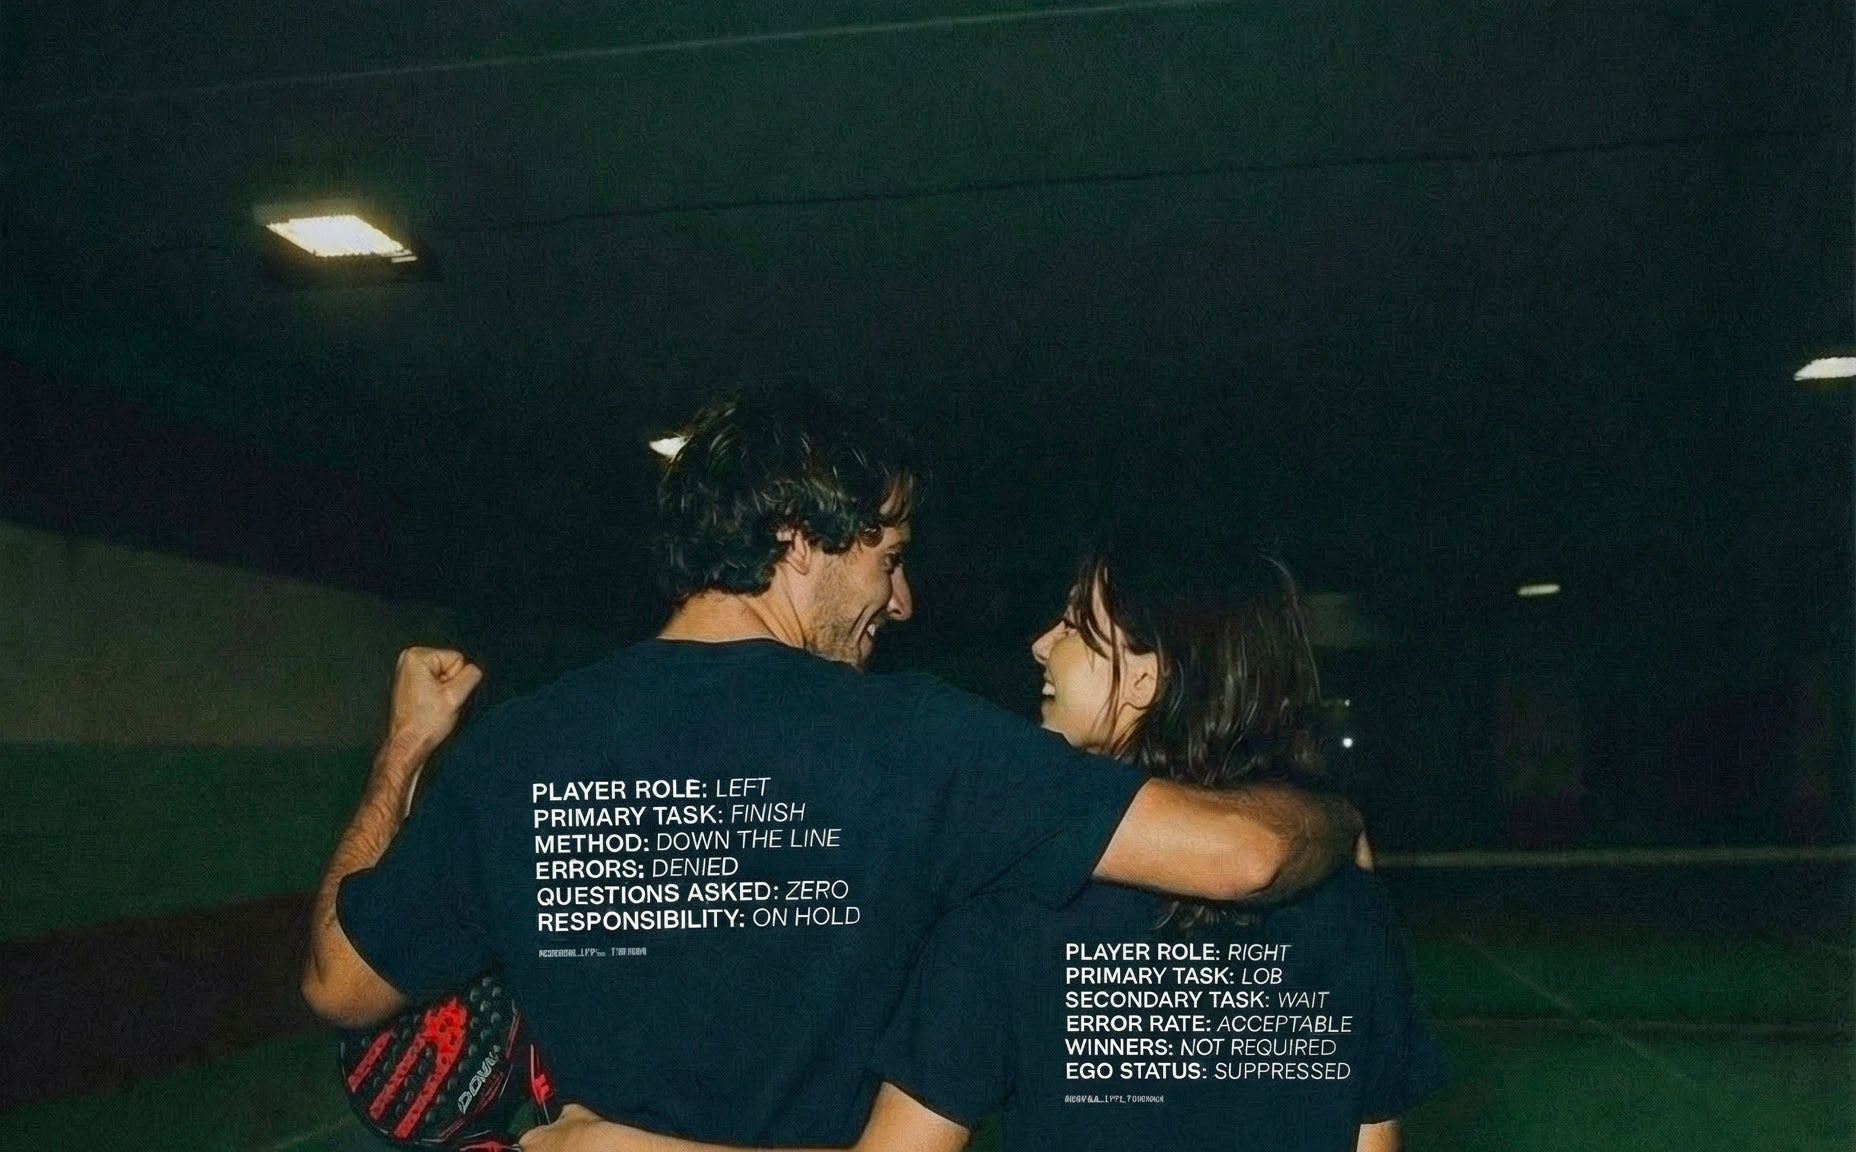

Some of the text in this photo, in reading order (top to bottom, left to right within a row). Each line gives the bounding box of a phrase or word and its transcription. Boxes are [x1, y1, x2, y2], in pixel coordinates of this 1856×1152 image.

[532, 776, 772, 804] PLAYER ROLE: LEFT
[533, 802, 806, 829] PRIMARY TASK: FINISH
[534, 828, 842, 854] METHOD: DOWN THE LINE
[535, 856, 739, 880] ERRORS: DENIED
[536, 879, 849, 907] QUESTIONS ASKED: ZERO
[537, 906, 861, 932] RESPONSIBILITY: ON HOLD
[1065, 942, 1292, 962] PLAYER ROLE: RIGHT
[1065, 966, 1283, 985] PRIMARY TASK: LOB
[1065, 990, 1330, 1009] SECONDARY TASK: WAIT
[1066, 1014, 1354, 1033] ERROR RATE: ACCEPTABLE
[1064, 1037, 1337, 1057] WINNERS: NOT REQUIRED
[1065, 1061, 1351, 1081] EGO STATUS: SUPPRESSED
